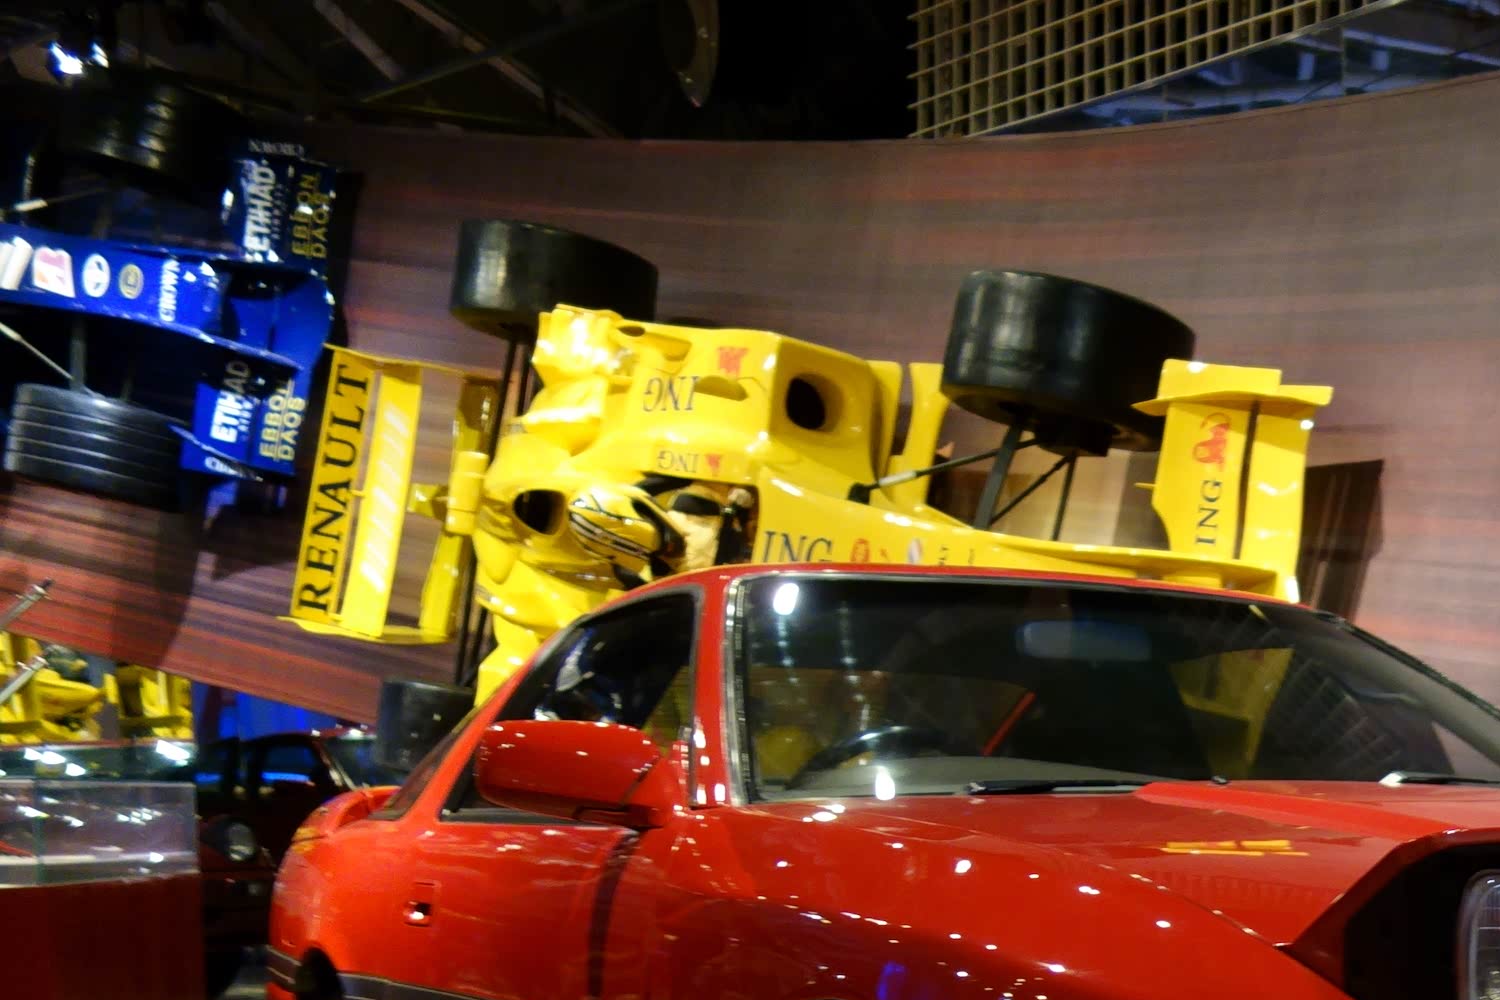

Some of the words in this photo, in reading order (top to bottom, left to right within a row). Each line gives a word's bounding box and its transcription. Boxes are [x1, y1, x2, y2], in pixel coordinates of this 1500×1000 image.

[244, 166, 276, 252] ETIHAD
[210, 361, 249, 443] ETIHAD
[643, 375, 700, 412] ING
[298, 364, 369, 614] RENAULT
[657, 449, 699, 473] ING
[1195, 479, 1223, 545] ING
[762, 530, 832, 563] ING
